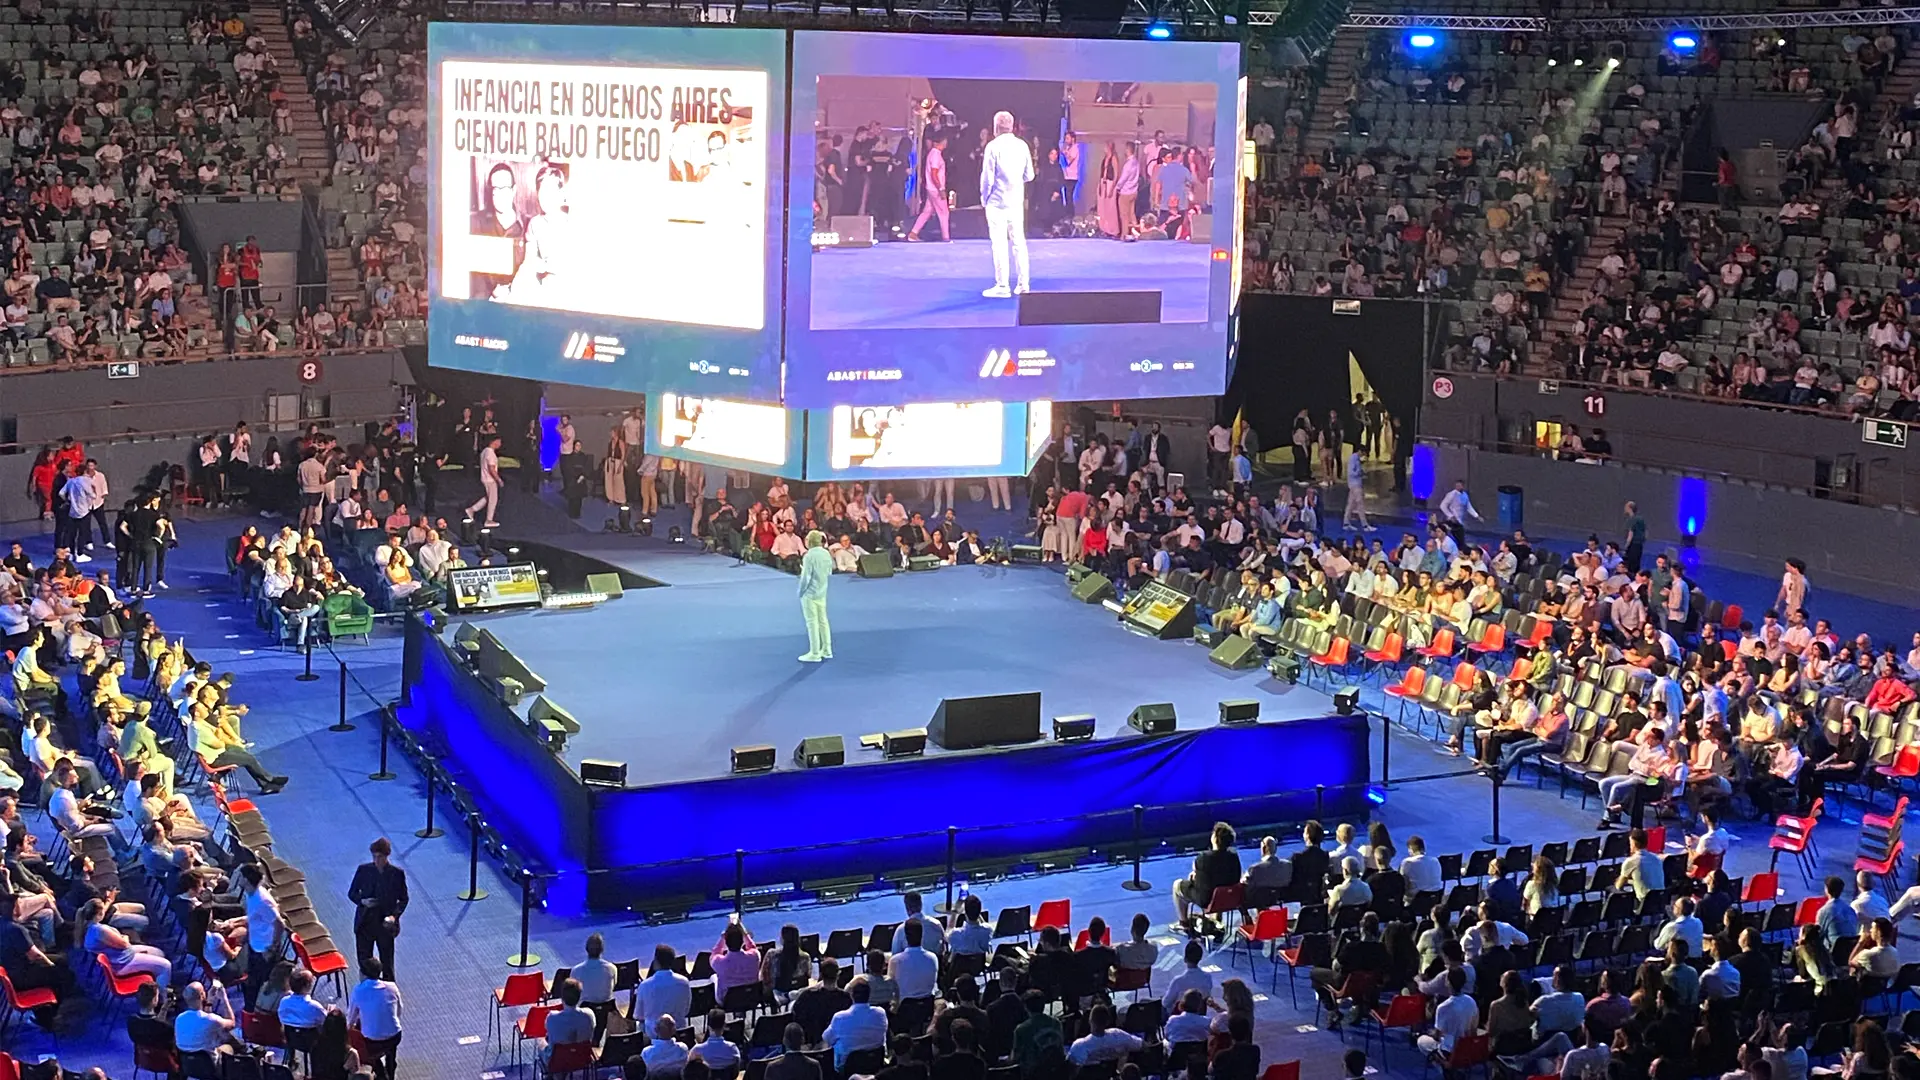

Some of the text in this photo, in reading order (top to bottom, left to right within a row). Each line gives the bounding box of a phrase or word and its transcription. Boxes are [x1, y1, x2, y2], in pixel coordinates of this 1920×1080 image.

[455, 78, 733, 124] INFANCIA EN BUENOS AIRES
[455, 118, 660, 162] CIENCIA BAJO FUEGO
[303, 363, 316, 379] 8
[1435, 381, 1451, 393] P3
[1584, 396, 1604, 414] 11
